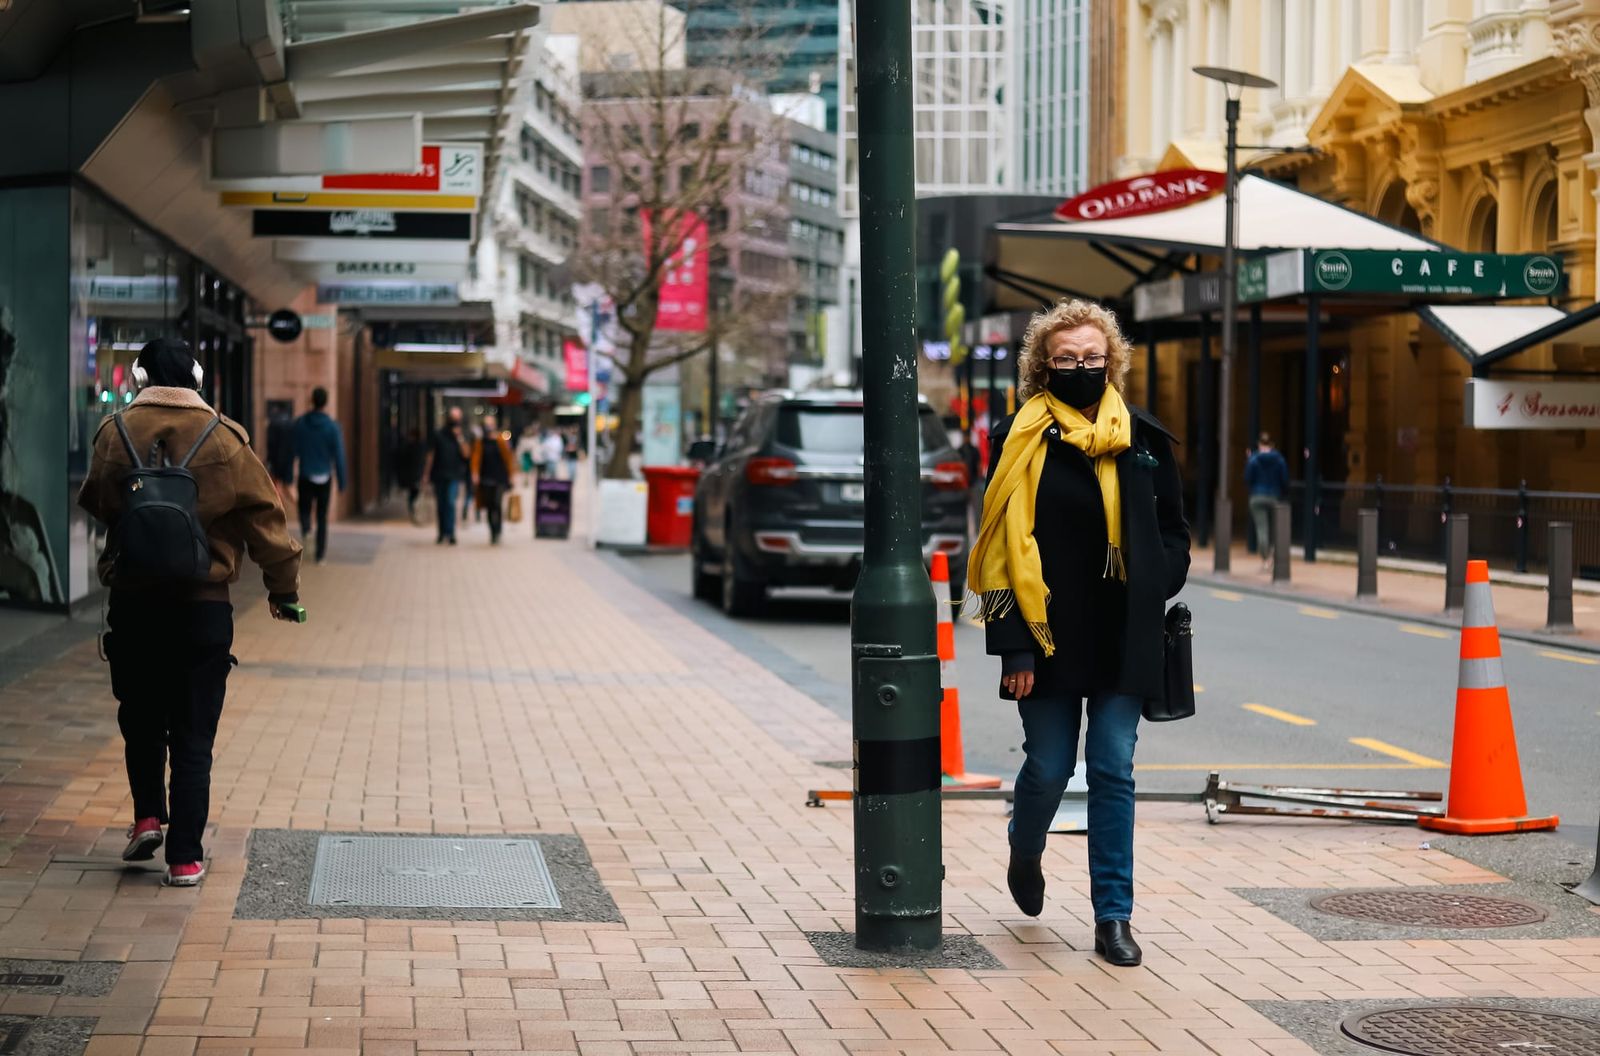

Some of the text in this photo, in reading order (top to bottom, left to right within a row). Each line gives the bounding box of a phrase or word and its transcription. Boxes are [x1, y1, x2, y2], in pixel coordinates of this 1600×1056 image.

[1078, 192, 1136, 219] OLD
[1138, 175, 1209, 203] BANK
[1320, 260, 1348, 273] Smith
[1391, 257, 1484, 278] CAFE
[1529, 266, 1554, 278] Smith
[1497, 390, 1596, 419] 4 Seasons
